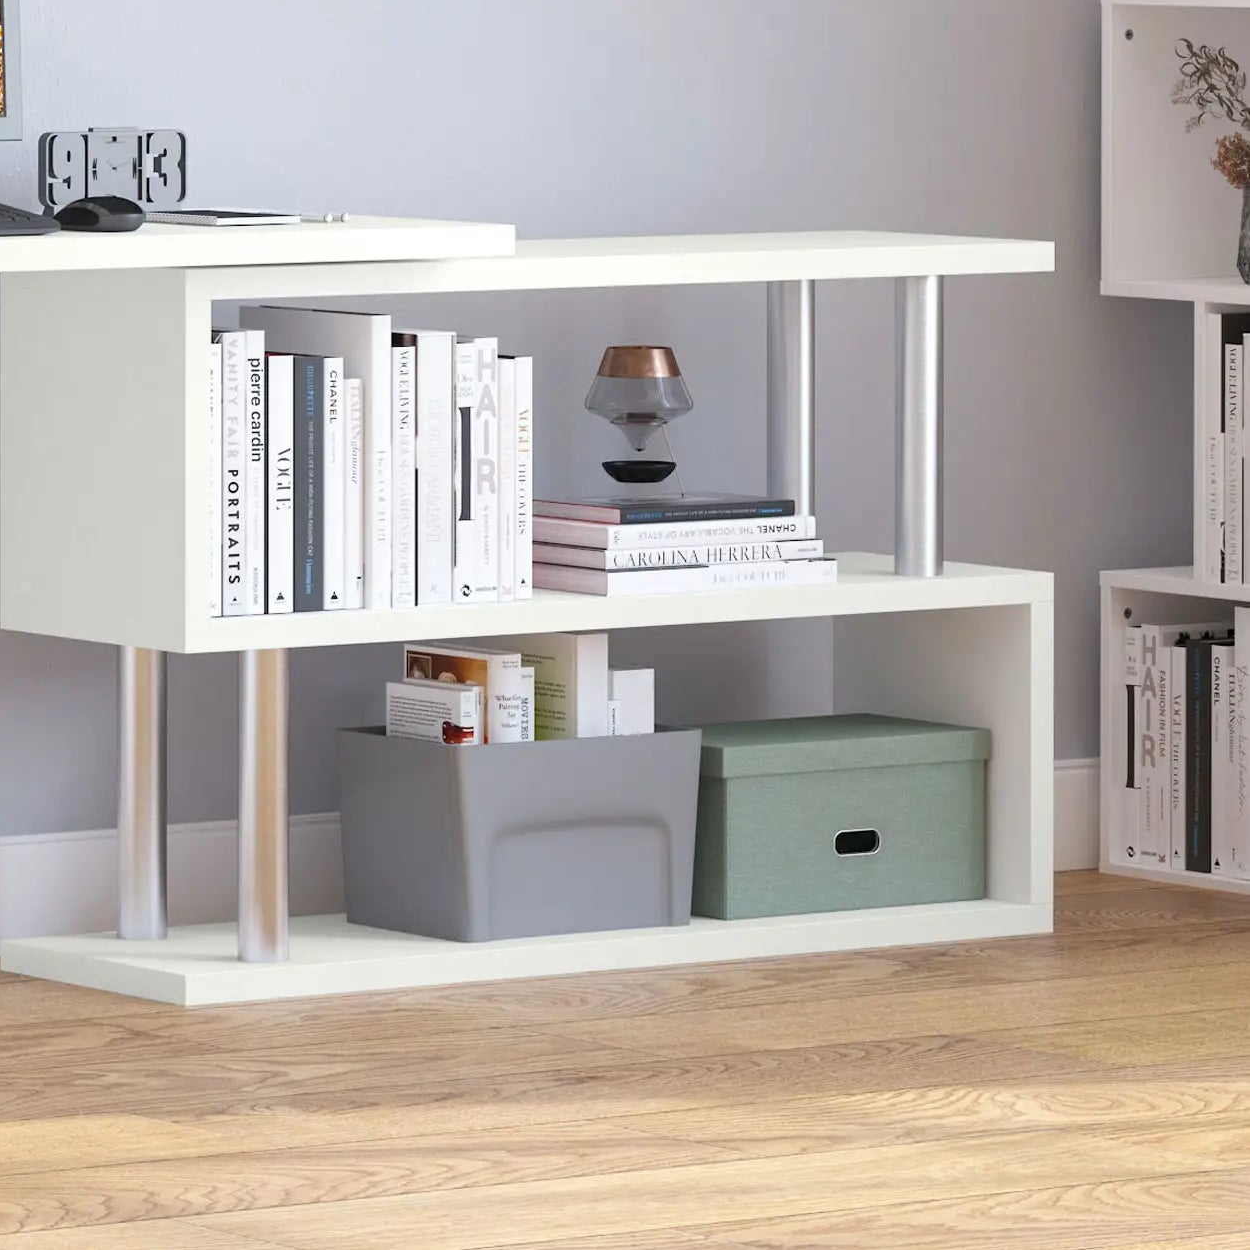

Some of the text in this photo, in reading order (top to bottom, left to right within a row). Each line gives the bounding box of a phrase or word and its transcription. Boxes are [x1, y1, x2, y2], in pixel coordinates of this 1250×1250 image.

[248, 357, 262, 406] pierre
[329, 370, 339, 424] CHANEL
[250, 411, 264, 463] cardin
[475, 348, 497, 495] HAIR
[518, 407, 530, 459] VOGUE
[227, 339, 241, 585] VANITY FAIR PORTRAITS
[275, 447, 291, 511] VOGUE
[518, 487, 527, 535] COVERS
[637, 523, 797, 542] CHANEL THE VOCABULARY OF STYLE
[613, 543, 783, 569] CAROLINA HERRERA
[1141, 634, 1157, 768] HAIR
[1158, 670, 1167, 717] FASHION
[1213, 656, 1221, 707] CHANEL
[1228, 674, 1236, 723] ITALIAN
[520, 697, 529, 740] MOVIES
[1159, 719, 1166, 730] IN
[1172, 694, 1182, 741] VOGUE
